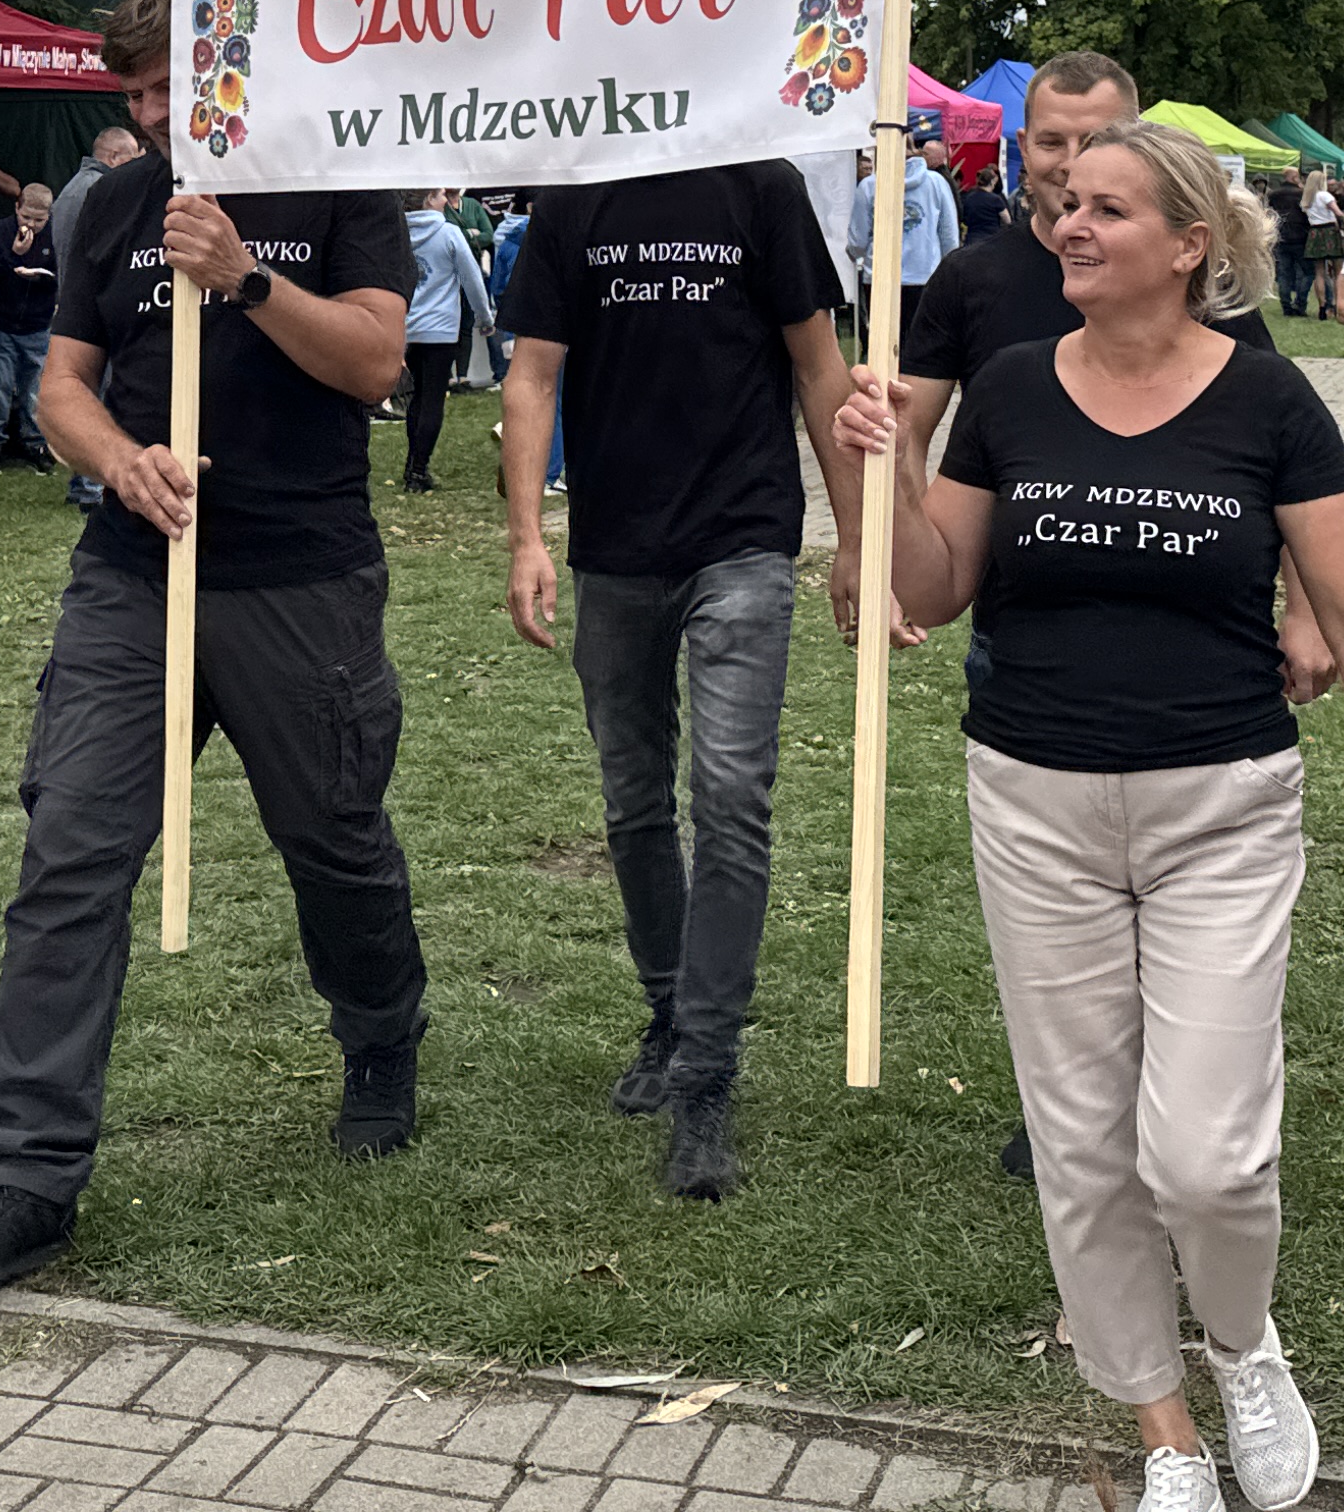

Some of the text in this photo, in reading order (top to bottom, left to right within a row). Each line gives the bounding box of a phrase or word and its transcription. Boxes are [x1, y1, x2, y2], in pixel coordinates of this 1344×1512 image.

[327, 76, 690, 147] w Mdzewku
[586, 242, 743, 266] KGW MDZEWKO
[600, 276, 725, 307] „Czar Par”
[1011, 482, 1242, 519] KGW MDZEWKO
[1017, 513, 1219, 555] „Czar Par”
